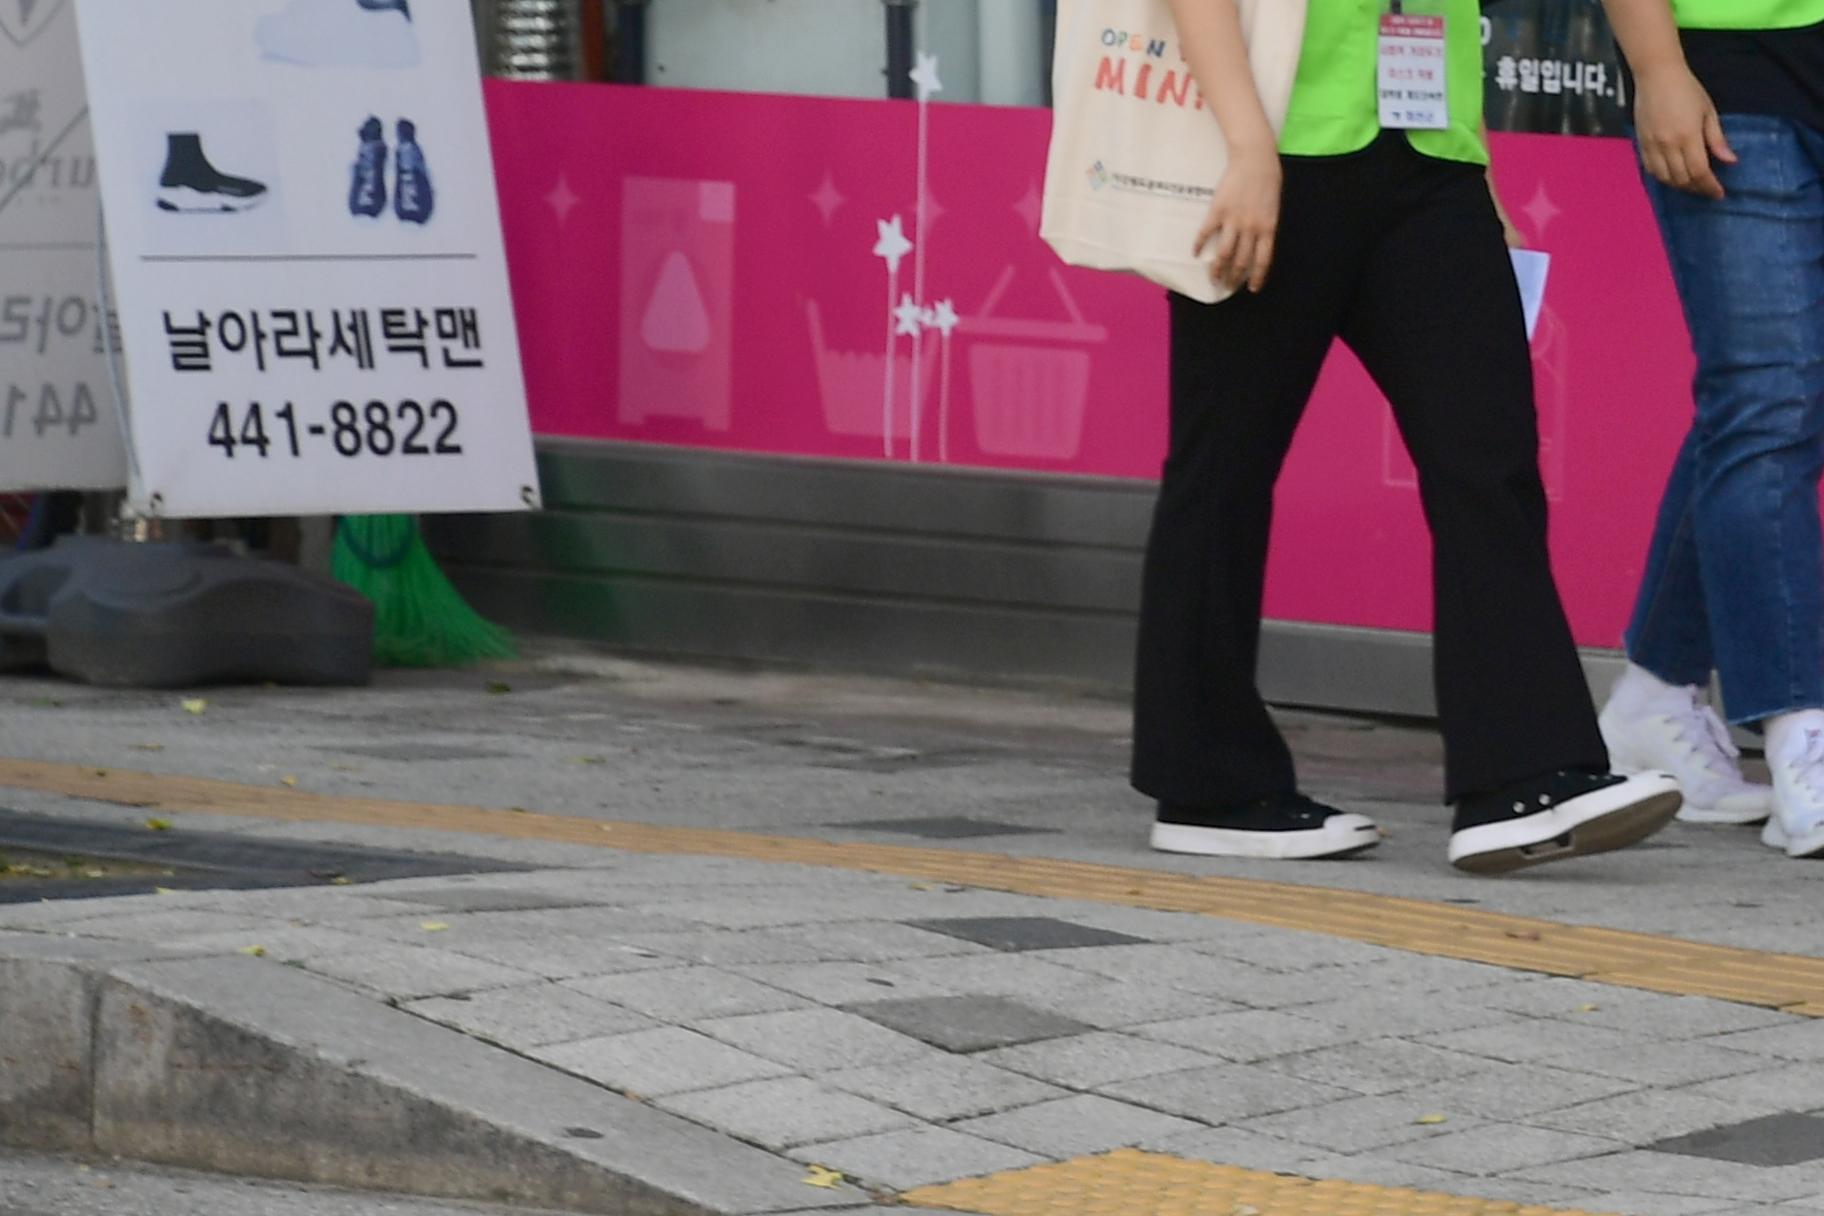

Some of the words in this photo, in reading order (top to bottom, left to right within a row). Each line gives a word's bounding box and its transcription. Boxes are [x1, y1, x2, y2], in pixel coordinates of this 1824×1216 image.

[1101, 27, 1167, 59] OPEN
[1093, 54, 1208, 112] MIN
[1494, 55, 1616, 98] 휴일입니다.
[162, 304, 486, 373] 날아라세탁맨
[207, 397, 464, 460] 441-8822
